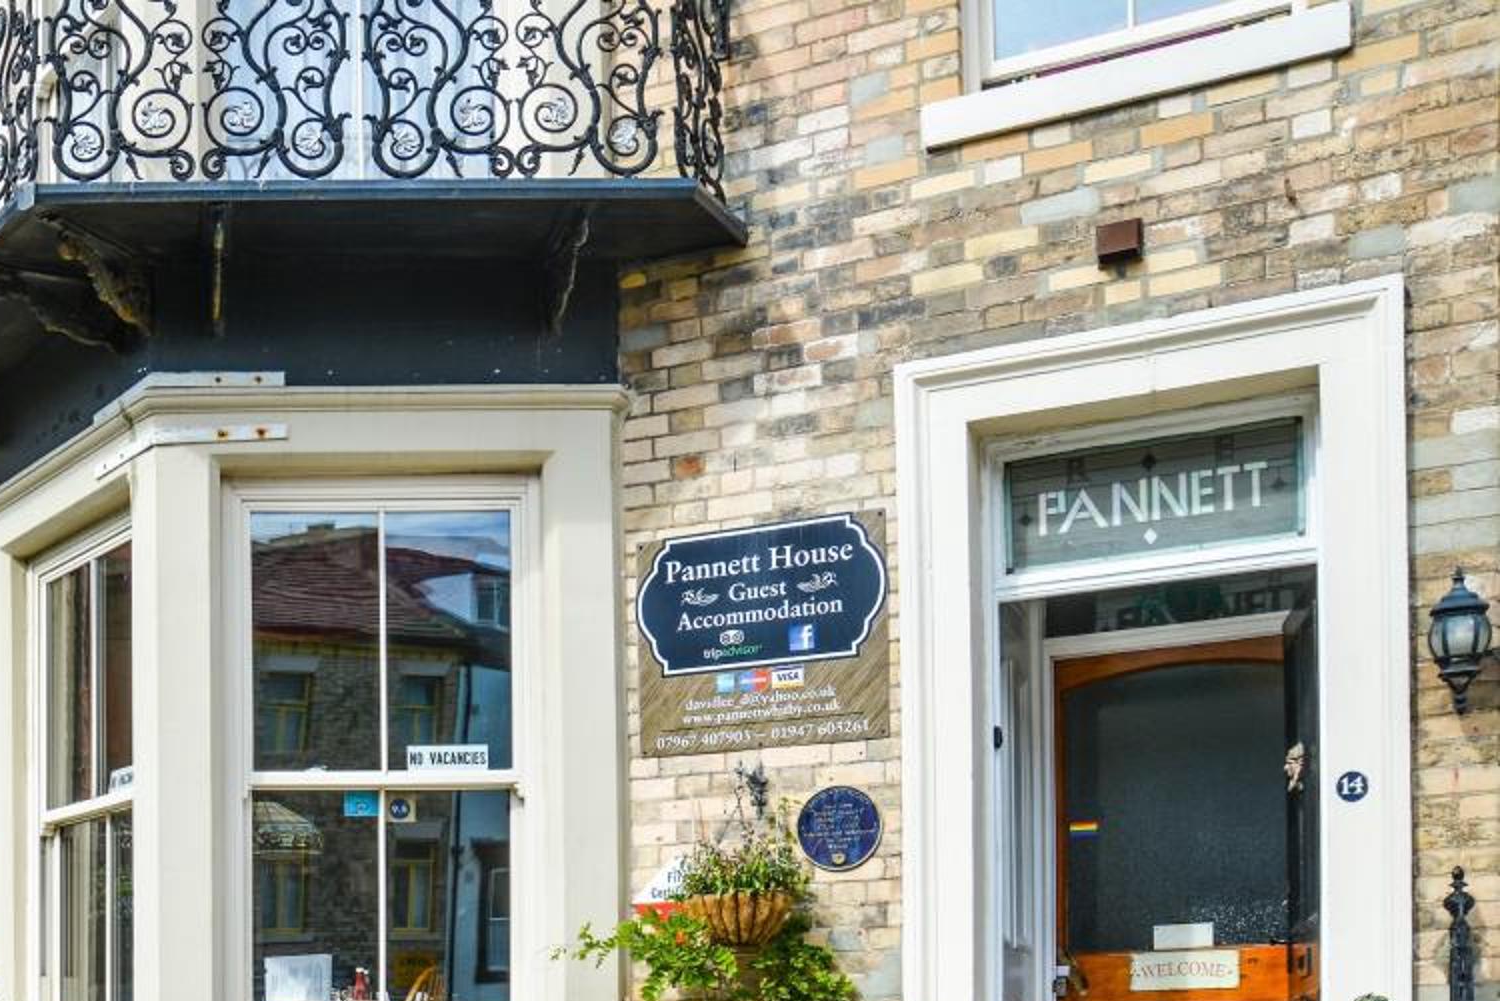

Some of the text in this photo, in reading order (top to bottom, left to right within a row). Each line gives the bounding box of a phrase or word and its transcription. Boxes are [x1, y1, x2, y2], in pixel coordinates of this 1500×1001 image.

[1038, 461, 1268, 537] PANNETT
[665, 543, 853, 585] Pannett House
[728, 581, 787, 602] Guest
[677, 596, 844, 632] Accommodation
[776, 671, 800, 682] VISA
[409, 751, 487, 765] NO VACANCIES
[1339, 775, 1364, 795] 14
[1141, 960, 1227, 978] WELCOME
